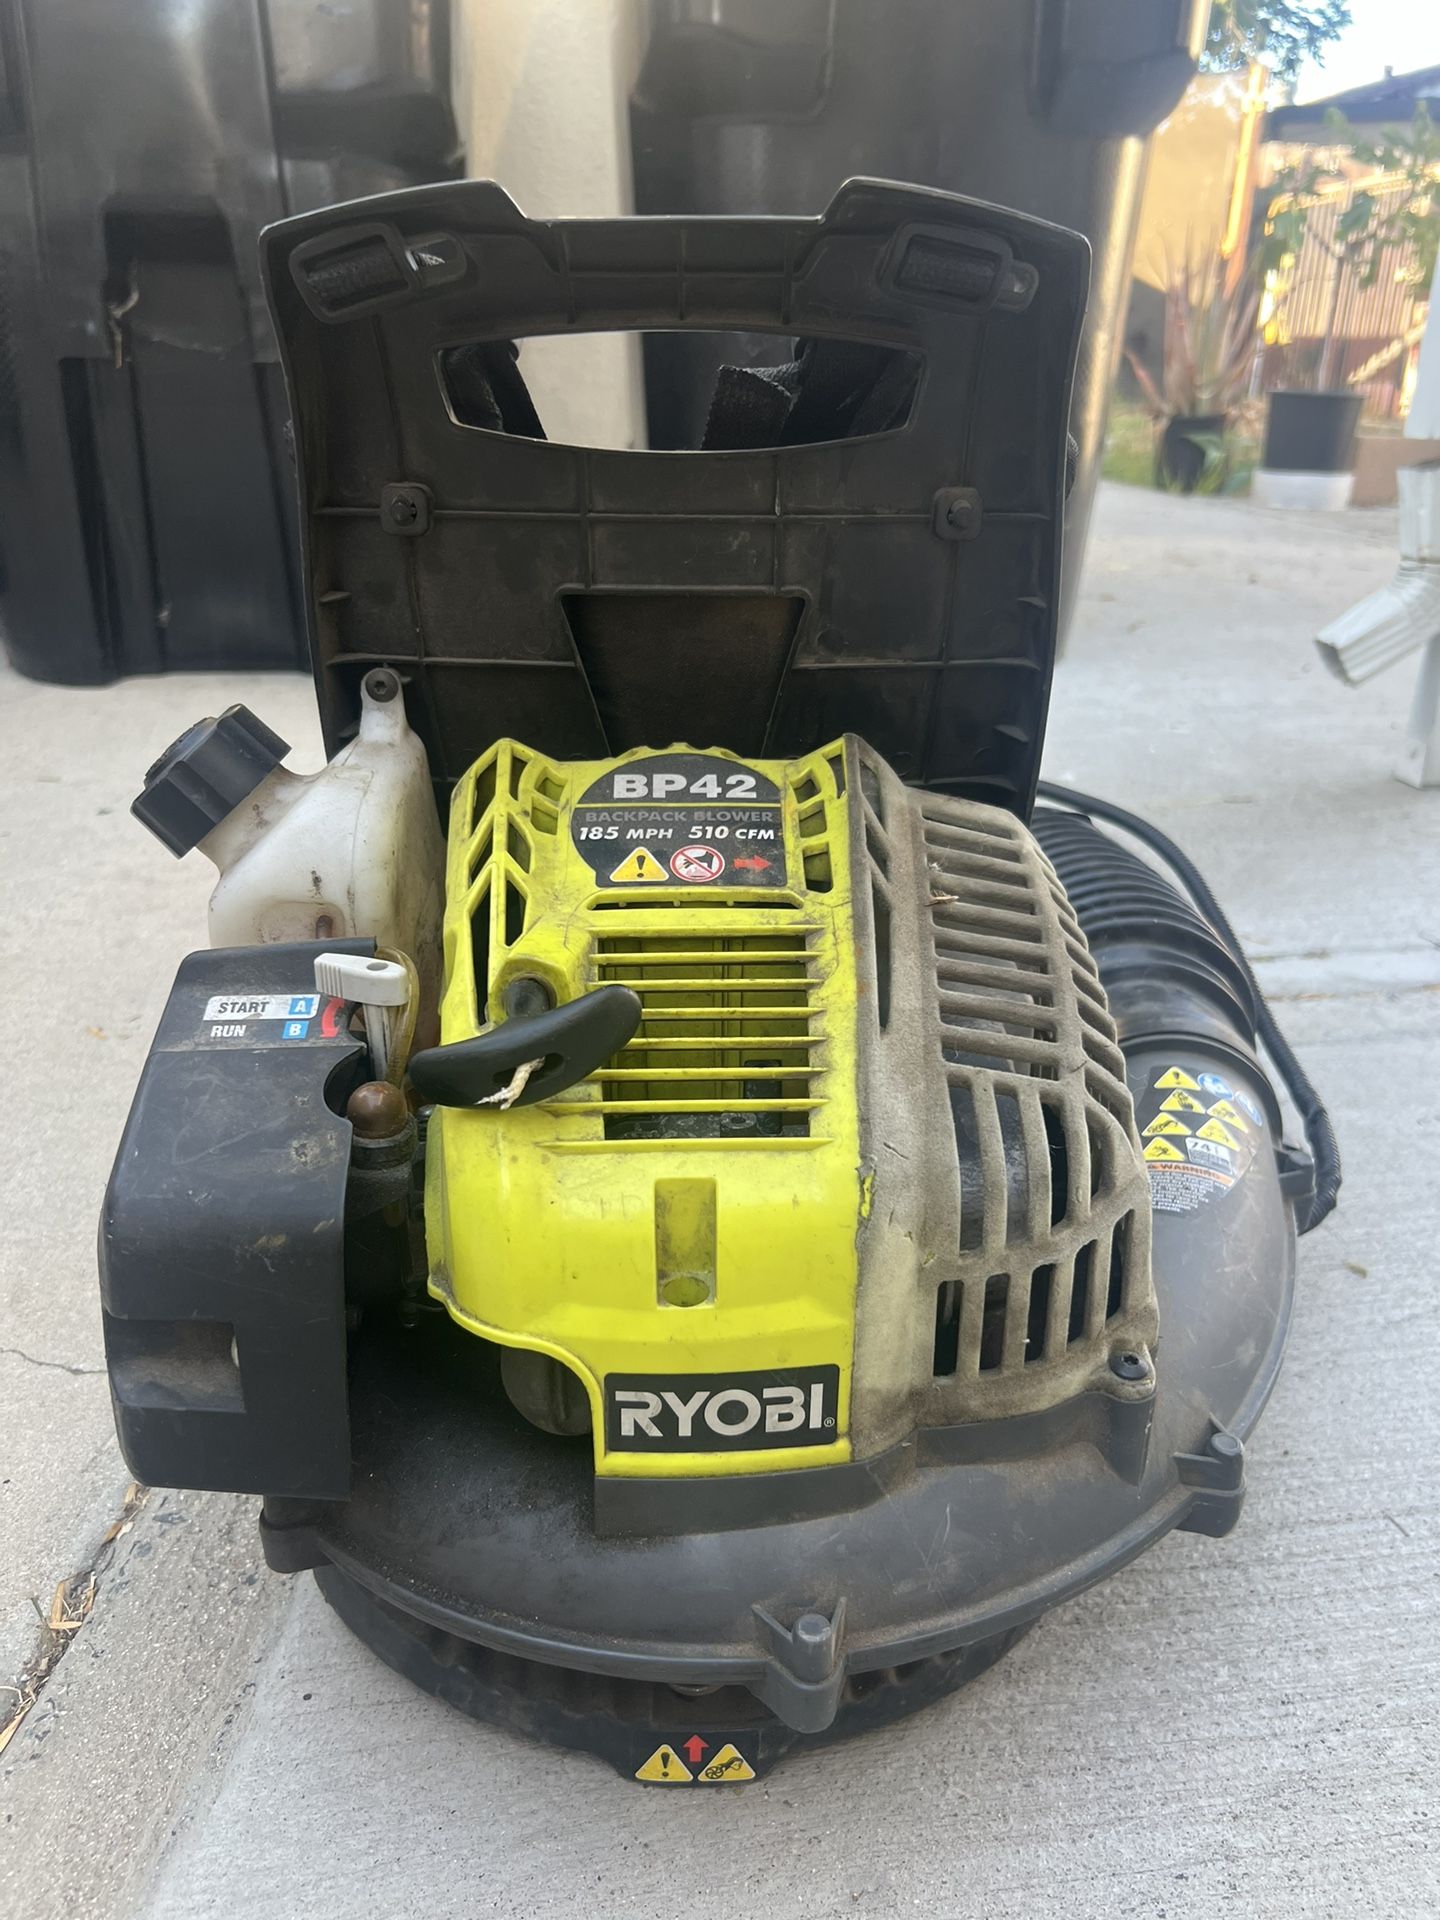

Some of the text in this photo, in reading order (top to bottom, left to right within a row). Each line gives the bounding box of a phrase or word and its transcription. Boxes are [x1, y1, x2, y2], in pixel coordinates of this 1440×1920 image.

[613, 773, 757, 799] BP42
[585, 811, 773, 822] BACKPACK BLOWER
[579, 825, 775, 840] 185 MPH 510 CFM
[218, 1000, 306, 1014] START A
[210, 1024, 301, 1037] RUN B
